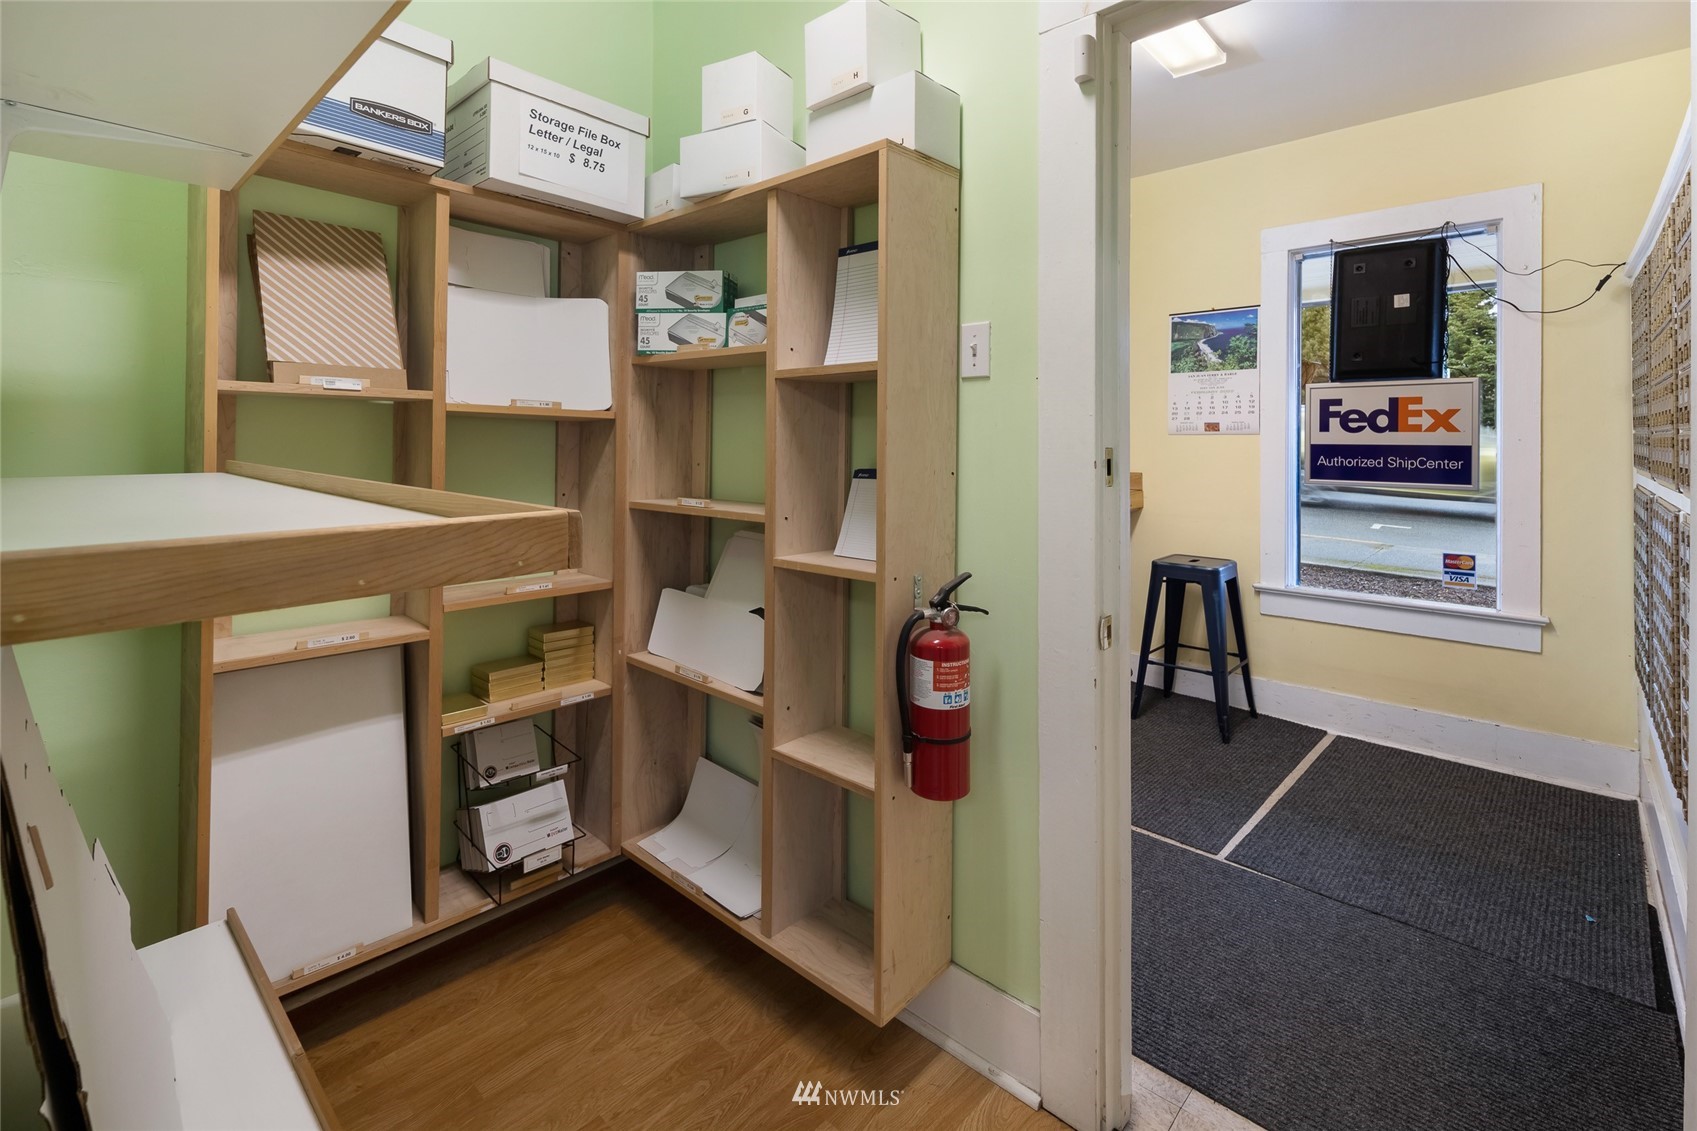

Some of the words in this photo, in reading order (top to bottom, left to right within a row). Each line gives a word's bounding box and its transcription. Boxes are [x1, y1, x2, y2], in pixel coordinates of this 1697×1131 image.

[354, 102, 406, 123] BANKERS
[407, 119, 429, 130] BOX
[529, 108, 574, 132] Storage
[578, 126, 598, 140] File
[600, 134, 621, 149] Box
[529, 124, 564, 144] Letter
[566, 137, 571, 146] /
[573, 139, 603, 157] Legal
[569, 153, 575, 163] $
[583, 158, 605, 172] 8.75
[1319, 396, 1461, 434] FedEx
[1317, 455, 1384, 467] Authorized
[1387, 456, 1464, 470] ShipCenter
